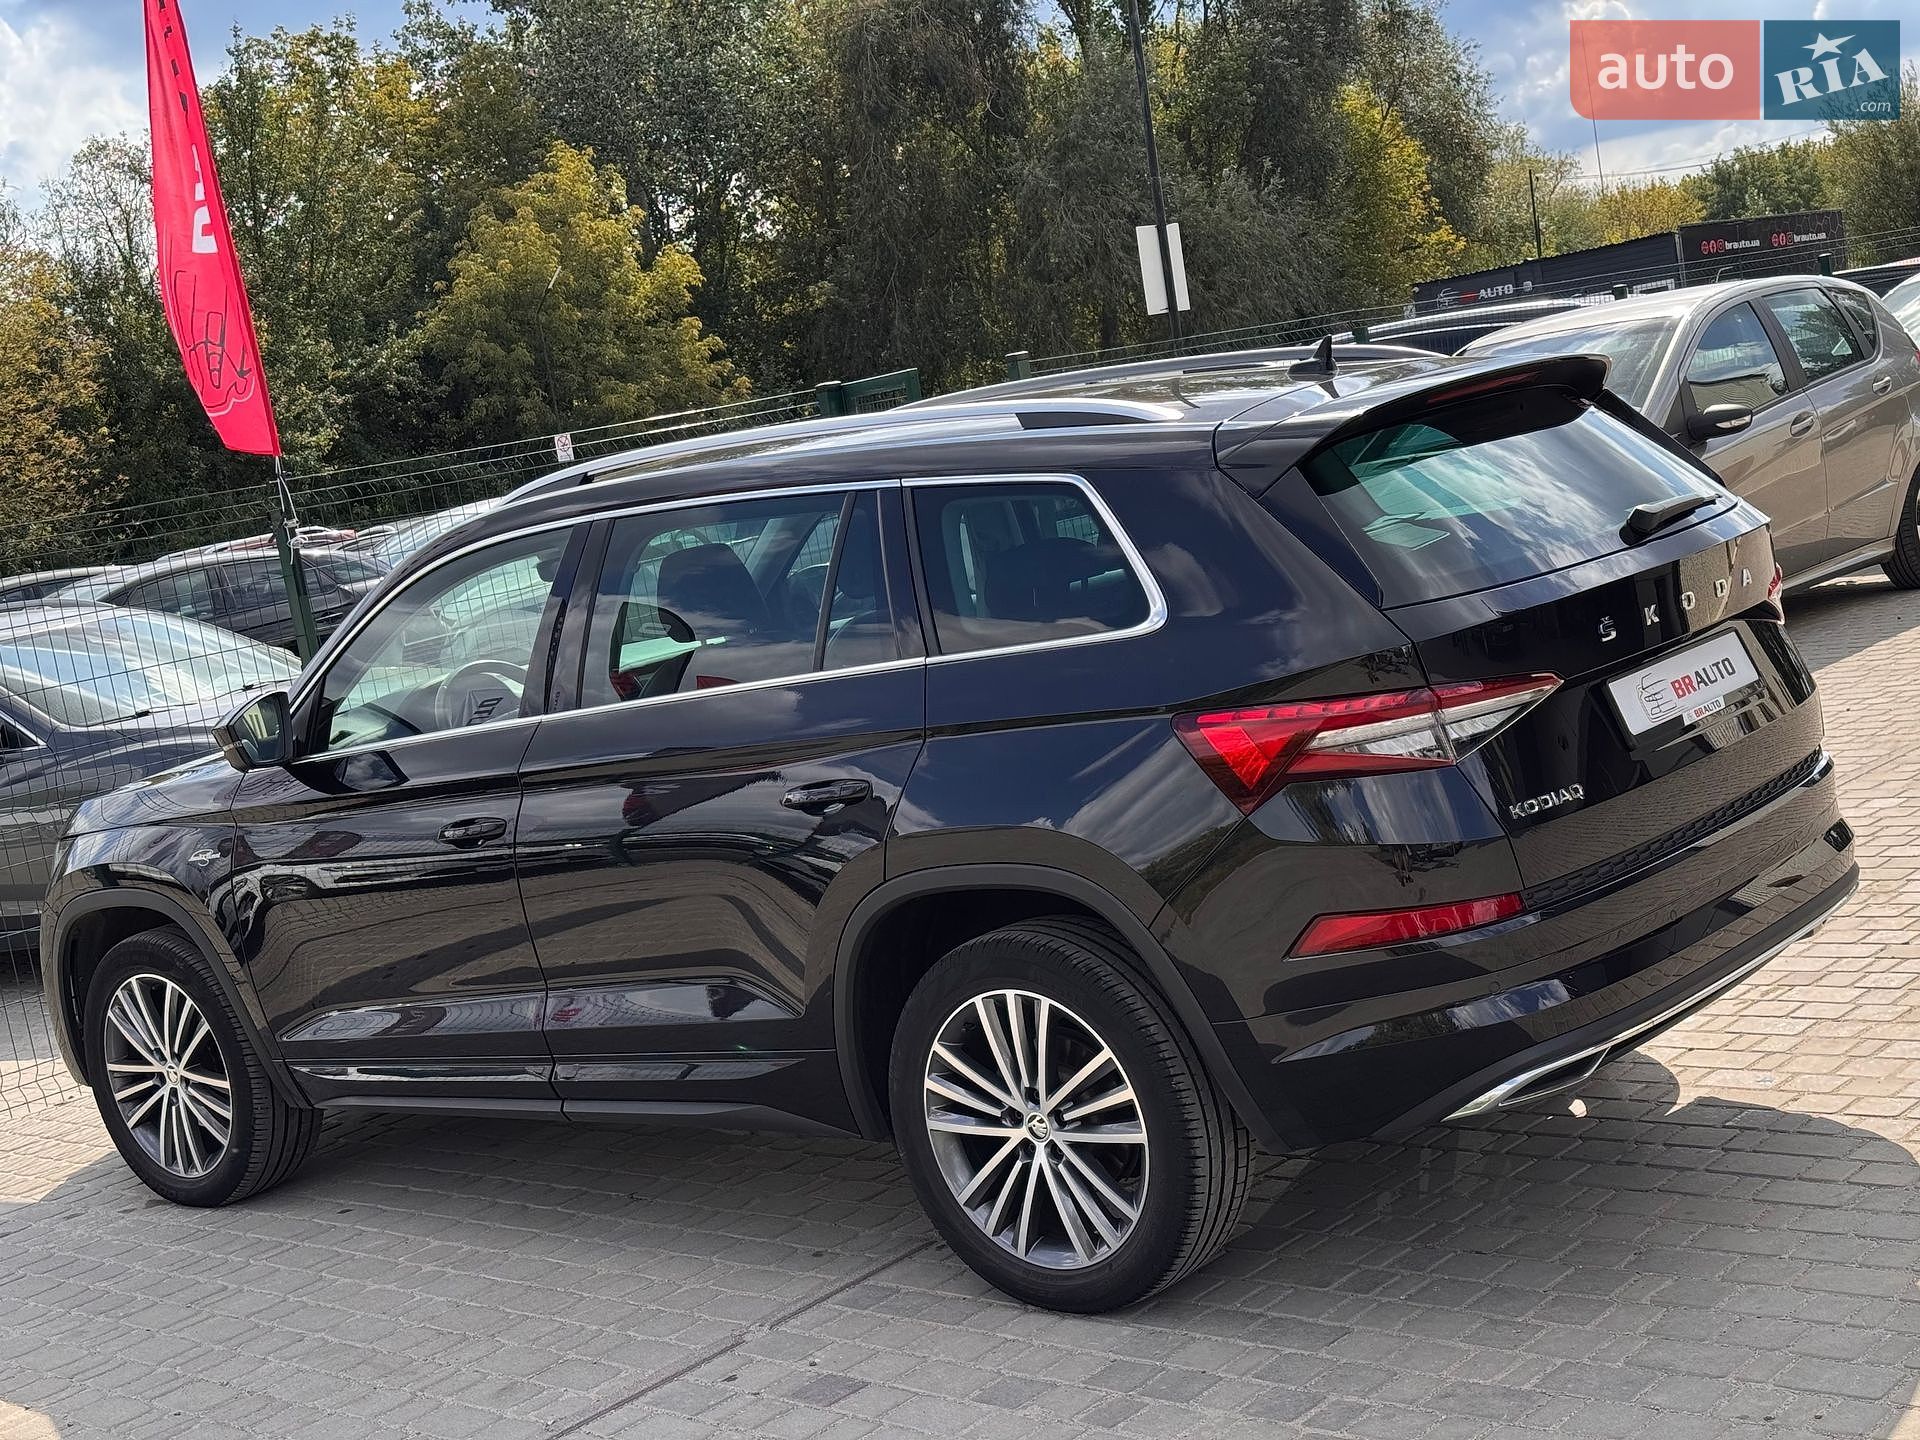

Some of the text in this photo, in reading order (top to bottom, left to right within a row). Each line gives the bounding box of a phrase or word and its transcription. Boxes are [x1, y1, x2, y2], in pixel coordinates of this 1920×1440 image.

[1670, 657, 1736, 699] BRAUTO
[1693, 699, 1722, 718] BRAUTO
[1508, 783, 1585, 820] KODIAQ
